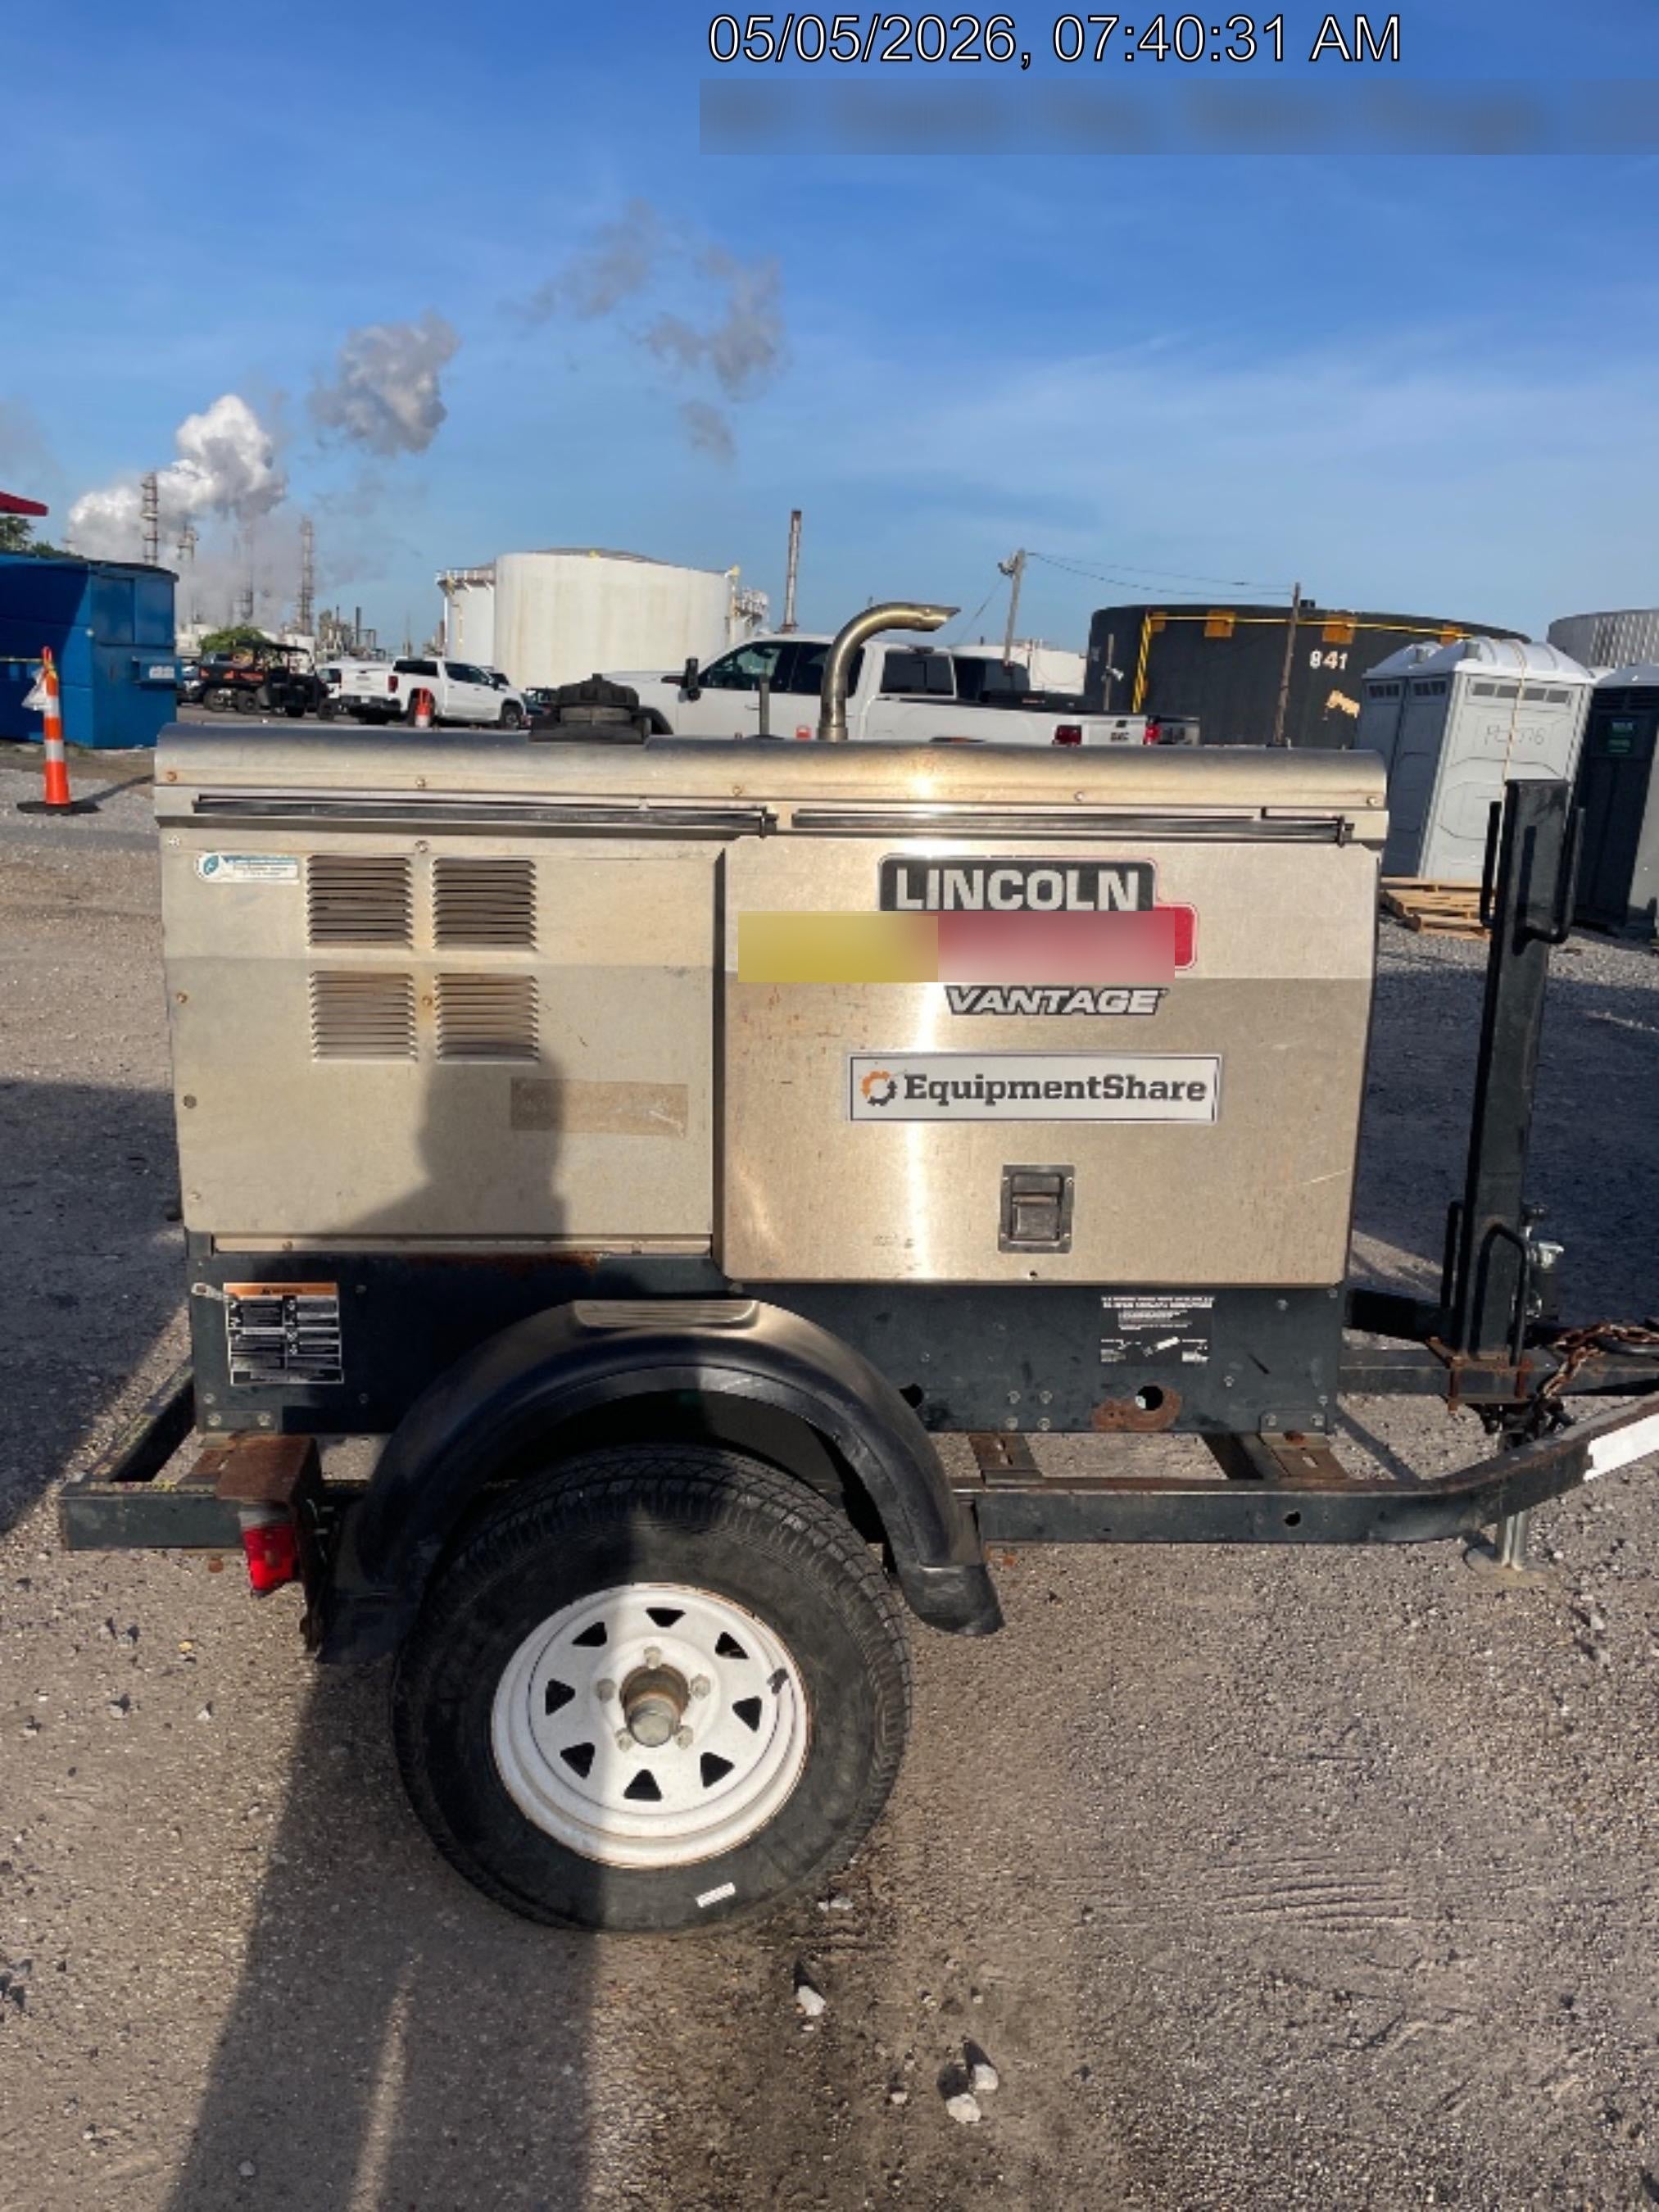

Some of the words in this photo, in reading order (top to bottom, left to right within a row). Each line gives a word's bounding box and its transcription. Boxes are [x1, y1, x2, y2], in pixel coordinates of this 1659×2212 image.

[1309, 650, 1349, 670] 841
[895, 868, 1140, 911] LINCOLN
[949, 986, 1163, 1015] VANTAGE
[904, 1074, 1207, 1106] EquipmentShare
